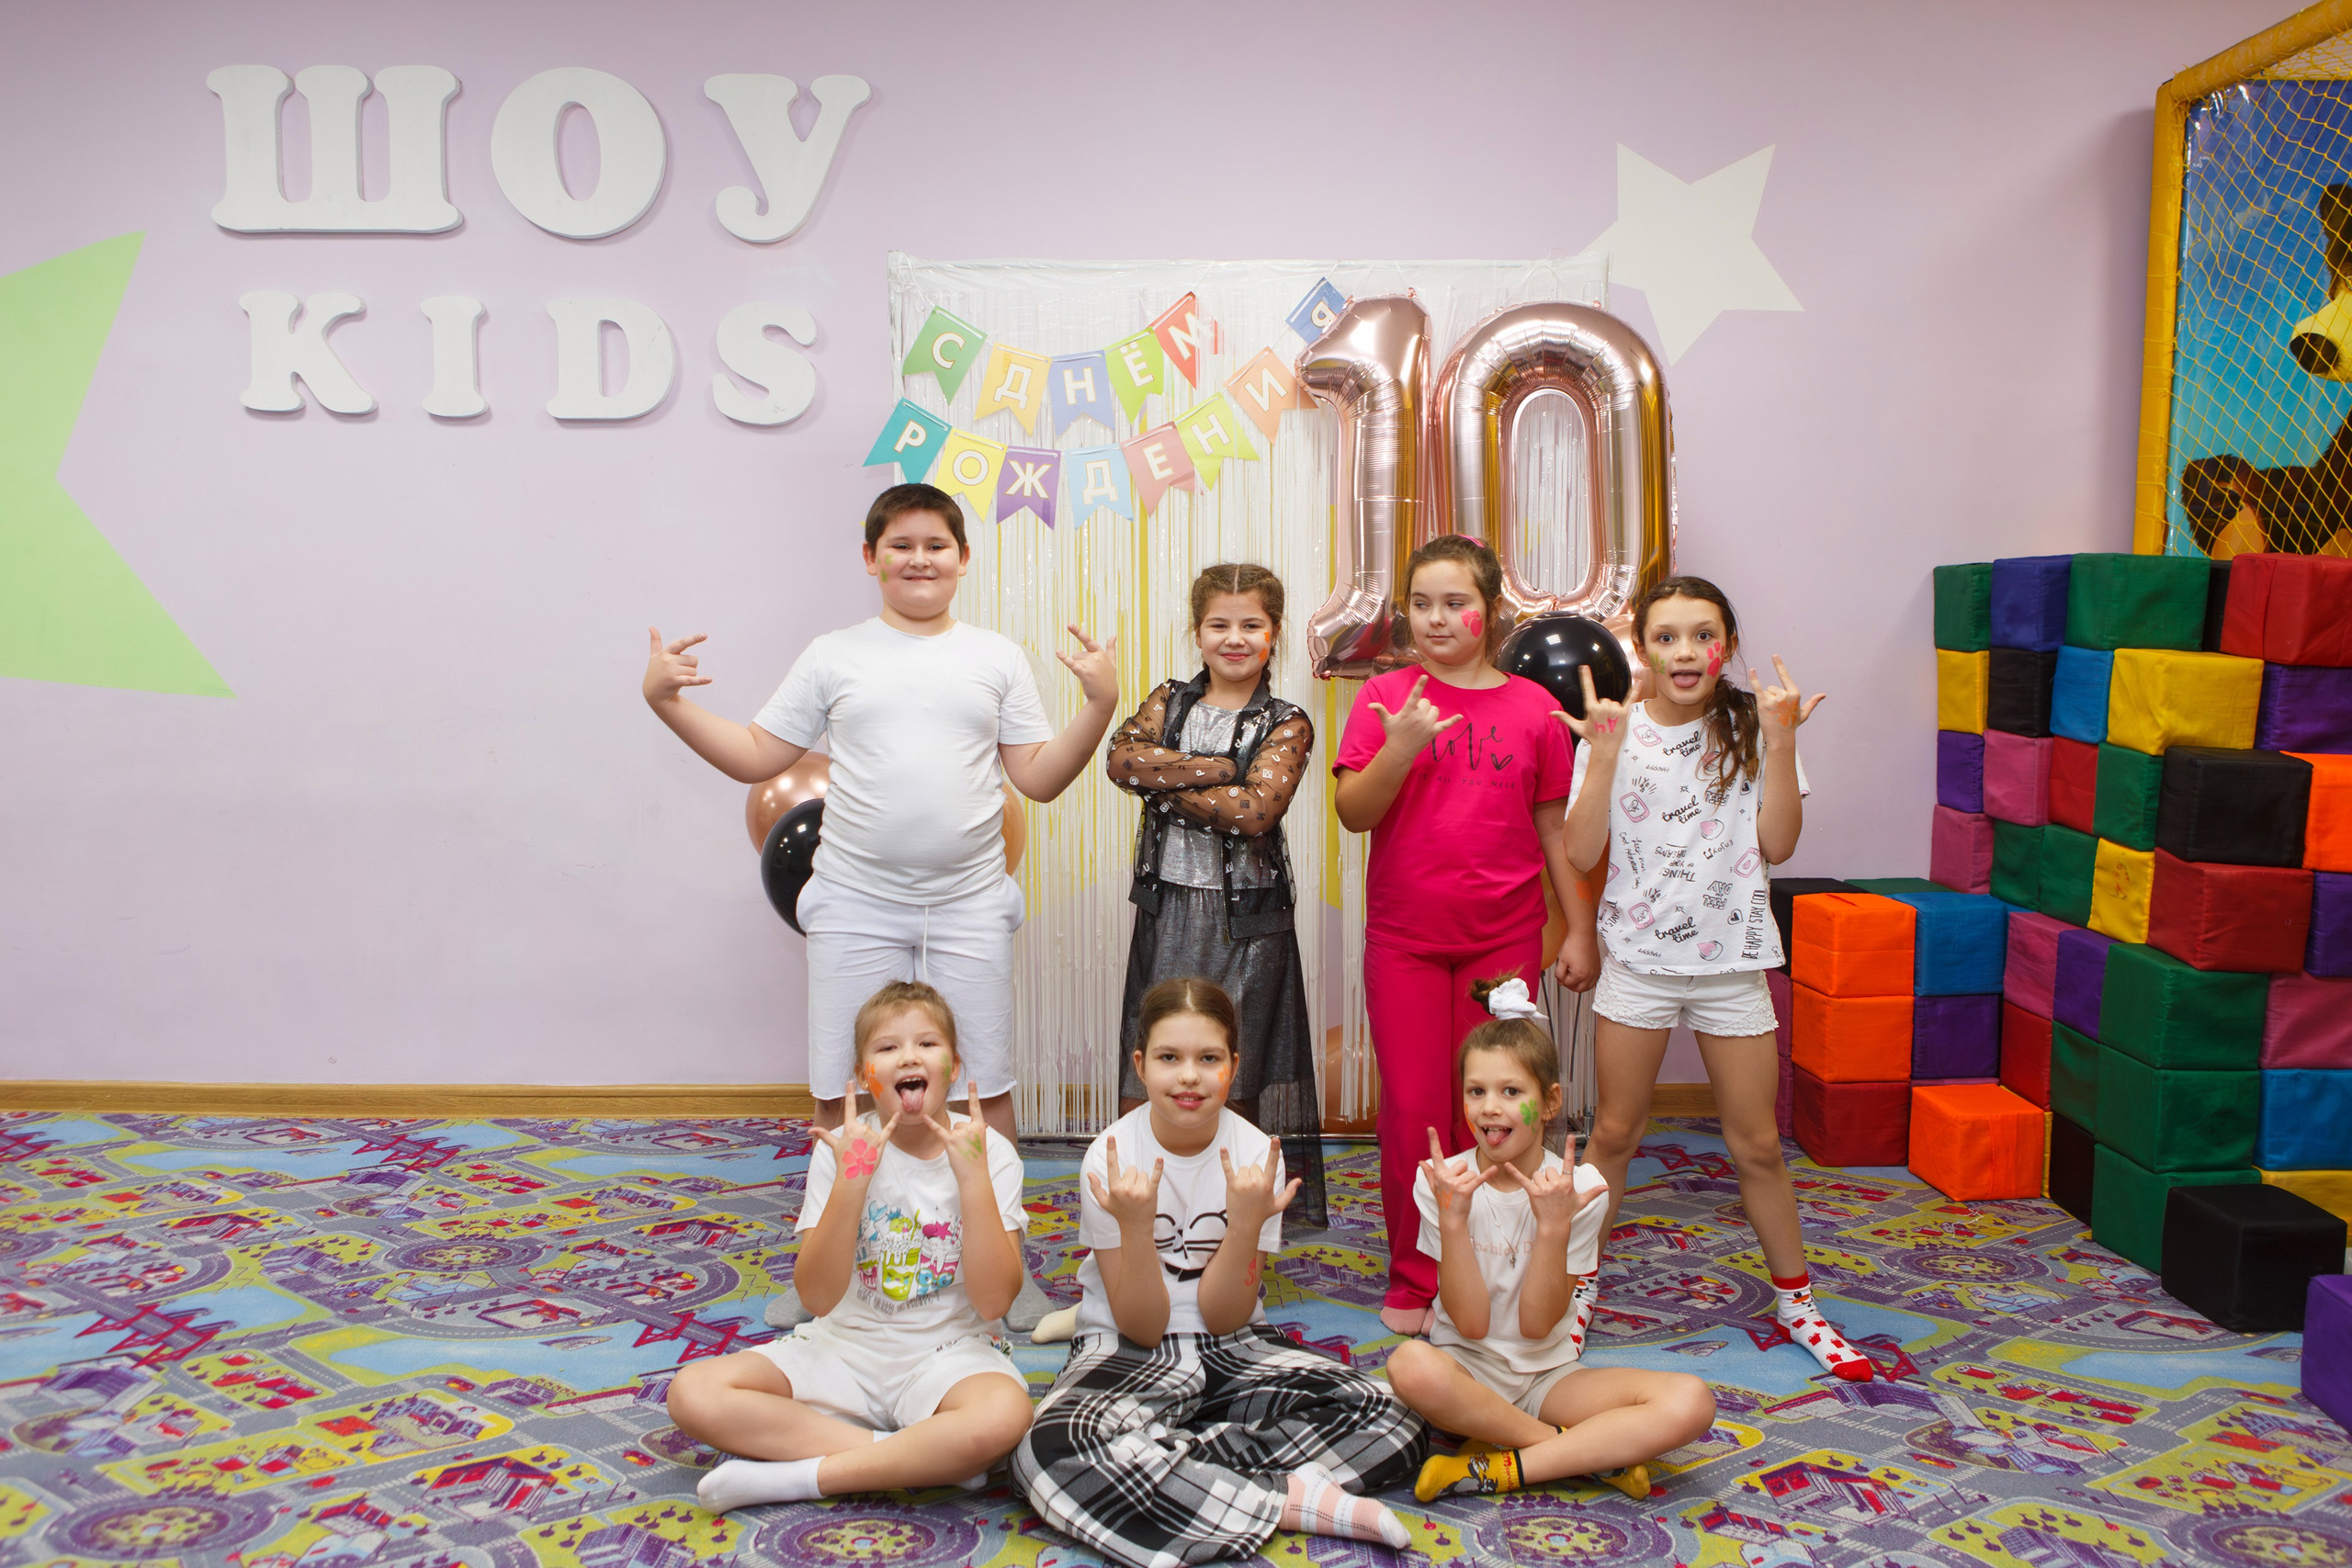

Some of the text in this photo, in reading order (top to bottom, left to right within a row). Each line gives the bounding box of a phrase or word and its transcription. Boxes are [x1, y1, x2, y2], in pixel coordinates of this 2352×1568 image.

[206, 64, 872, 243] ШОУ
[238, 289, 819, 426] KIDS
[931, 311, 1211, 410] С ДНЁМ
[1295, 294, 1676, 680] 10
[1661, 730, 1701, 756] travel
[1679, 742, 1702, 757] time
[1462, 778, 1482, 786] YOU
[1661, 795, 1700, 822] travel
[1678, 807, 1702, 824] time
[1702, 895, 1728, 910] FEEL
[1748, 906, 1766, 924] STAY
[1655, 916, 1697, 940] travel
[1672, 929, 1700, 943] time
[1745, 925, 1765, 951] HAPPY
